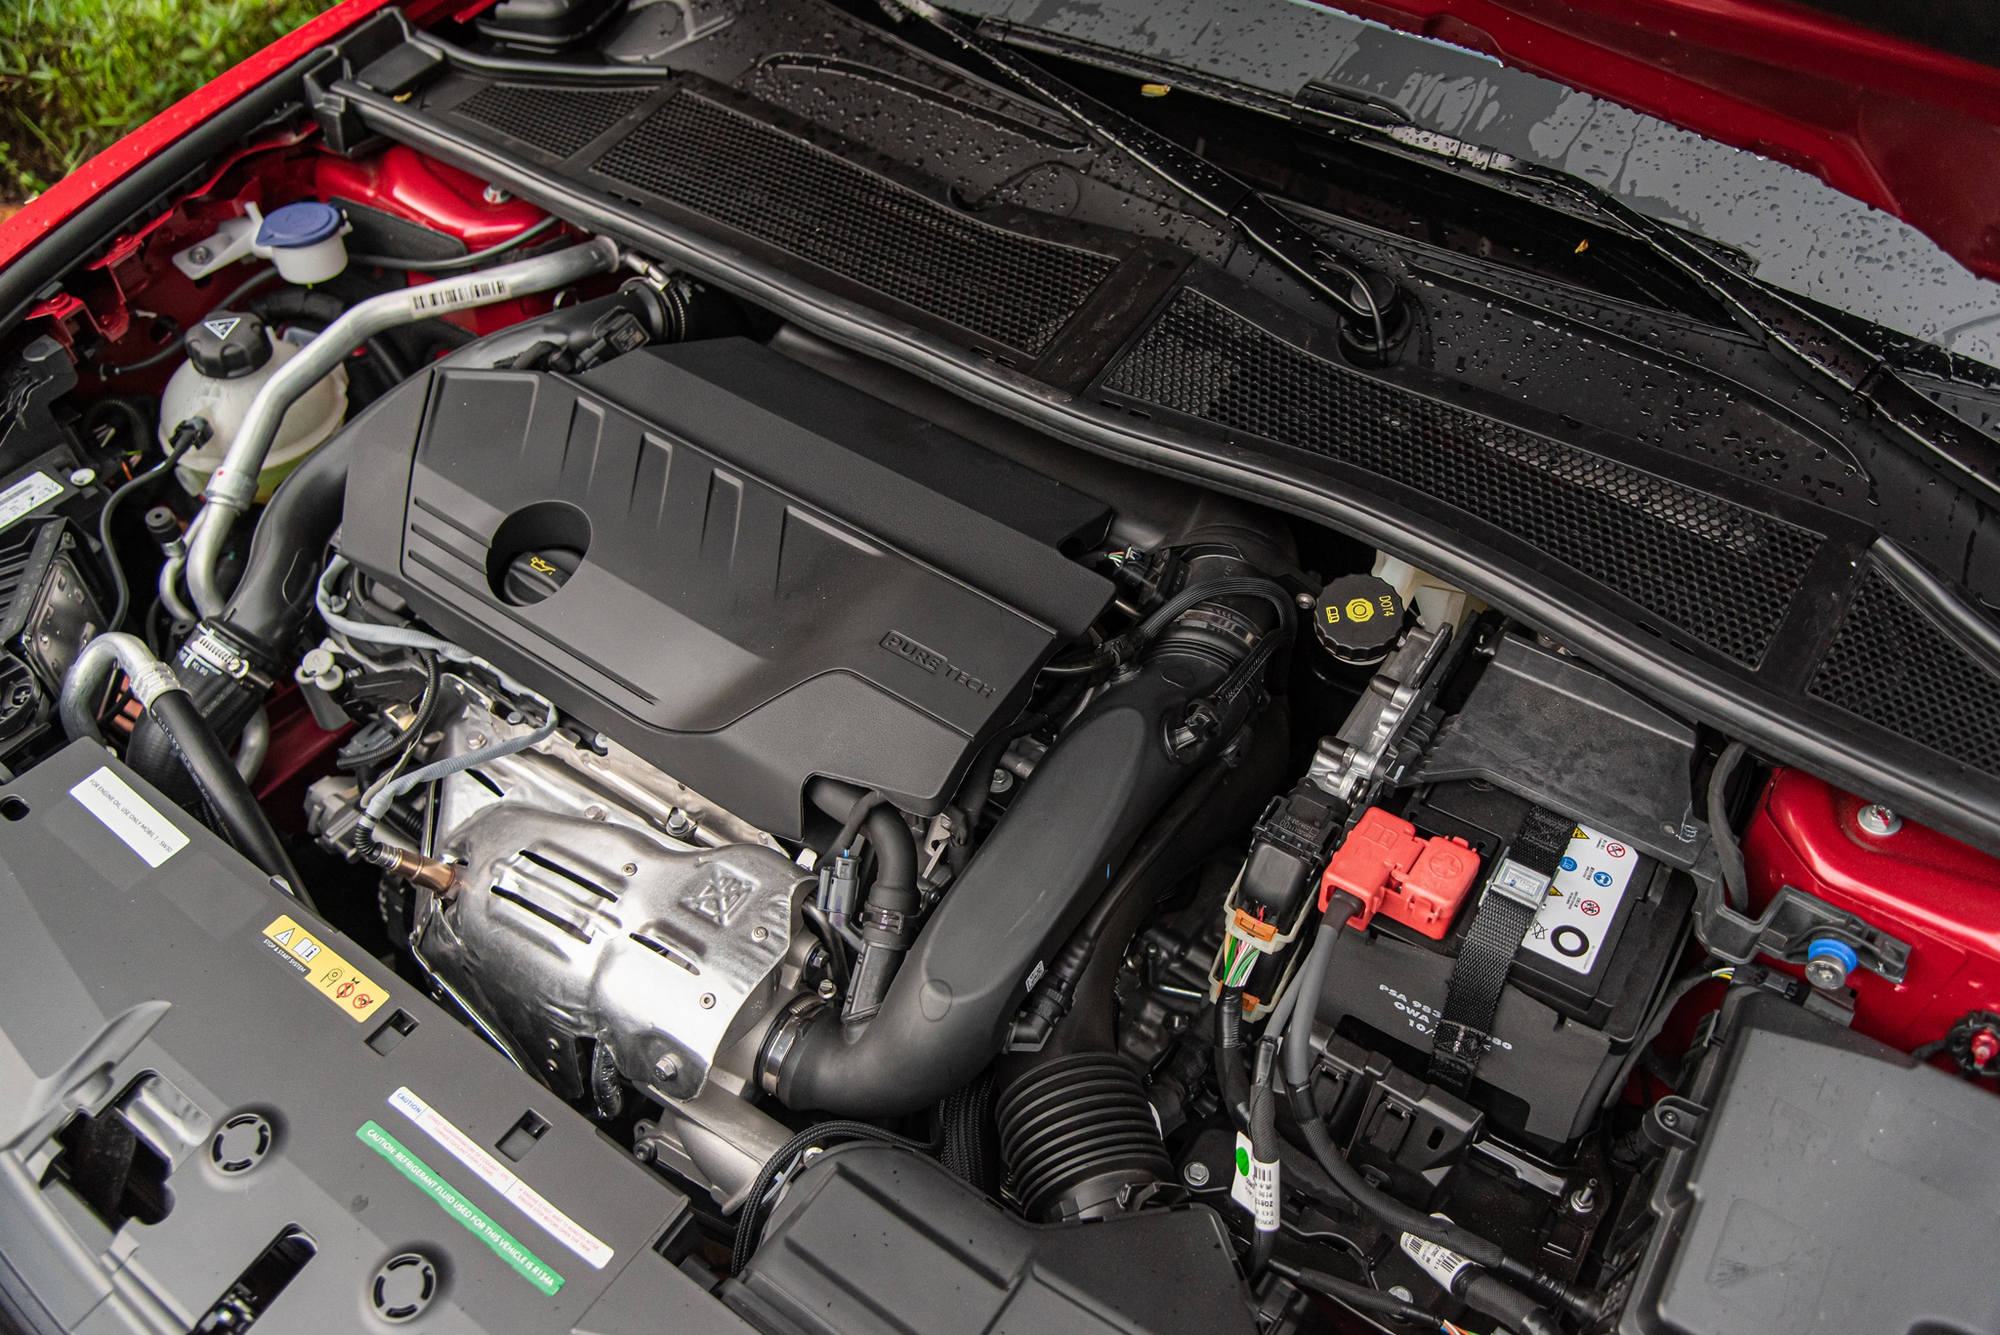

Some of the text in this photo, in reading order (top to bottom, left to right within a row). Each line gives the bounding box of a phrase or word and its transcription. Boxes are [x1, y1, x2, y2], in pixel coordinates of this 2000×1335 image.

[1379, 596, 1395, 617] DOT4
[886, 636, 996, 699] PURE TECH
[158, 717, 180, 750] GALAXY
[89, 778, 99, 788] FOR
[98, 786, 115, 802] ENGINE
[113, 799, 121, 810] OIL,
[121, 806, 131, 817] USE
[129, 813, 142, 826] ONLY
[139, 823, 155, 838] MOBIL
[263, 938, 276, 949] STOP
[277, 947, 292, 961] START
[289, 958, 306, 973] SYSTEM
[1379, 984, 1408, 1003] PSA
[1393, 1001, 1430, 1024] OWA
[397, 1092, 422, 1114] CAUTION
[426, 1113, 443, 1127] LOWEST
[474, 1149, 483, 1158] OF
[480, 1155, 499, 1173] COOLANT
[433, 1126, 451, 1141] CHANGE
[449, 1138, 468, 1156] COOLANT
[466, 1152, 480, 1165] EVERY
[481, 1165, 494, 1177] YEARS
[366, 1129, 555, 1287] CAUTION: REFRIGERANT FLUID USED FOR THIS VEHICLE IS R134A
[518, 1195, 591, 1253] ENGINE STOP BEFORE OPEN THE TANK
[522, 1190, 542, 1207] ENGINE
[552, 1212, 564, 1224] WAIT
[567, 1224, 587, 1242] MINUTES
[584, 1237, 600, 1250] AFTER
